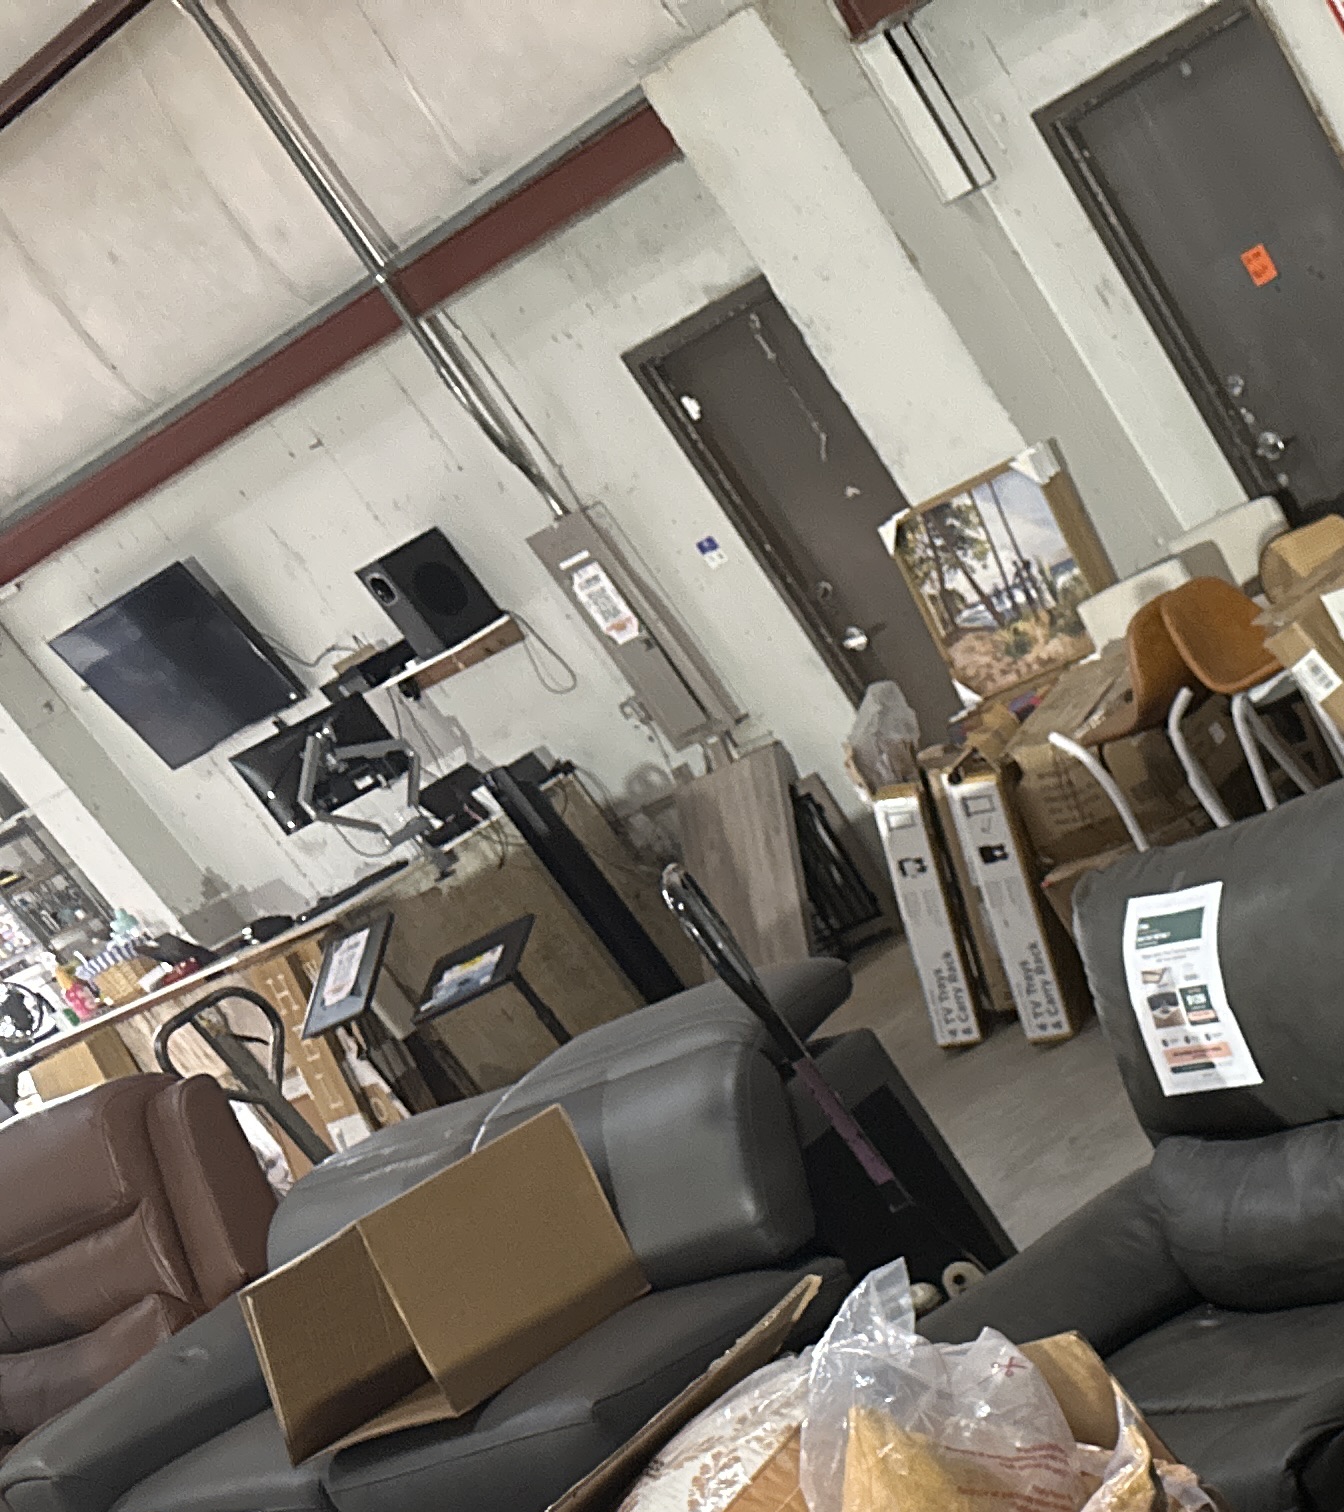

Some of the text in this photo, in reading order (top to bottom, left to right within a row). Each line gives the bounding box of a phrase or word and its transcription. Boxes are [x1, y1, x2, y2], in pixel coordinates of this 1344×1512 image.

[933, 967, 958, 1038] 4 TV Trays
[942, 951, 973, 1036] & Carry Rack
[1018, 960, 1048, 1032] 4 TV Trays
[1027, 941, 1063, 1031] & Carry Rack
